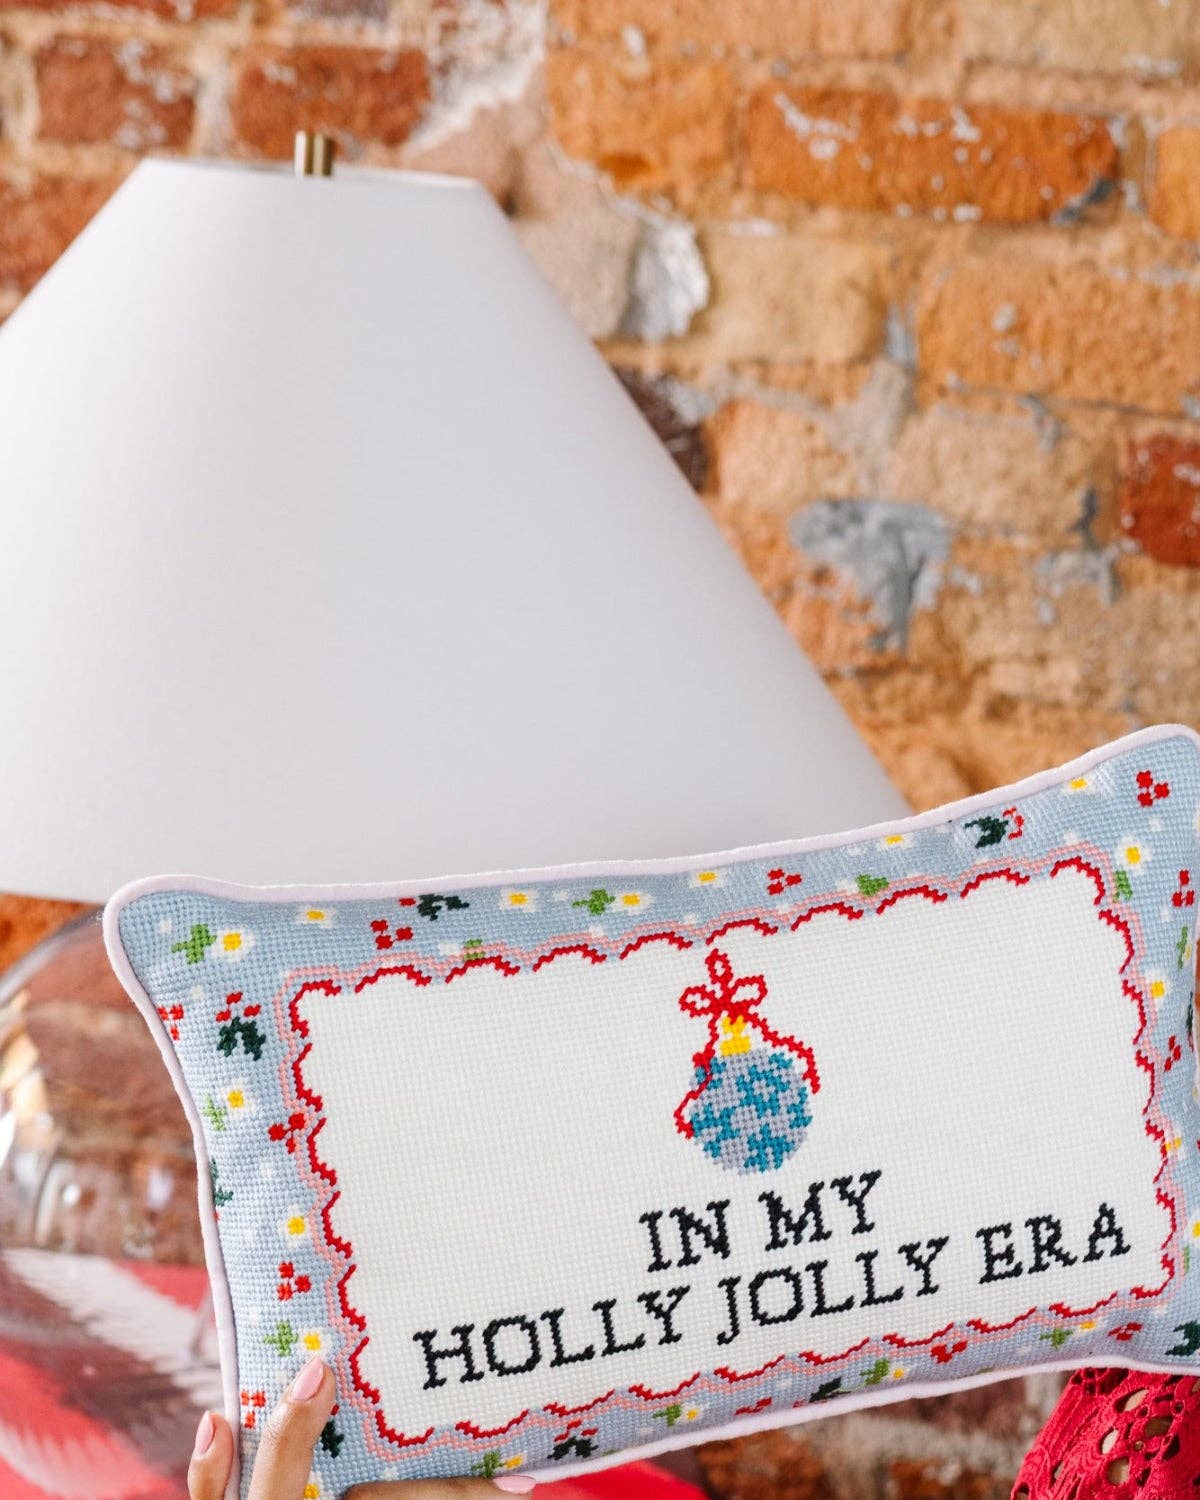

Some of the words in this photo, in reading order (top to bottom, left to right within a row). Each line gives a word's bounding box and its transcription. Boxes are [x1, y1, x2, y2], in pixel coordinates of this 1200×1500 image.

[638, 1198, 732, 1273] IN
[757, 1169, 882, 1252] MY
[412, 1285, 691, 1391] HOLLY
[716, 1235, 950, 1346] JOLLY
[975, 1202, 1132, 1285] ERA
